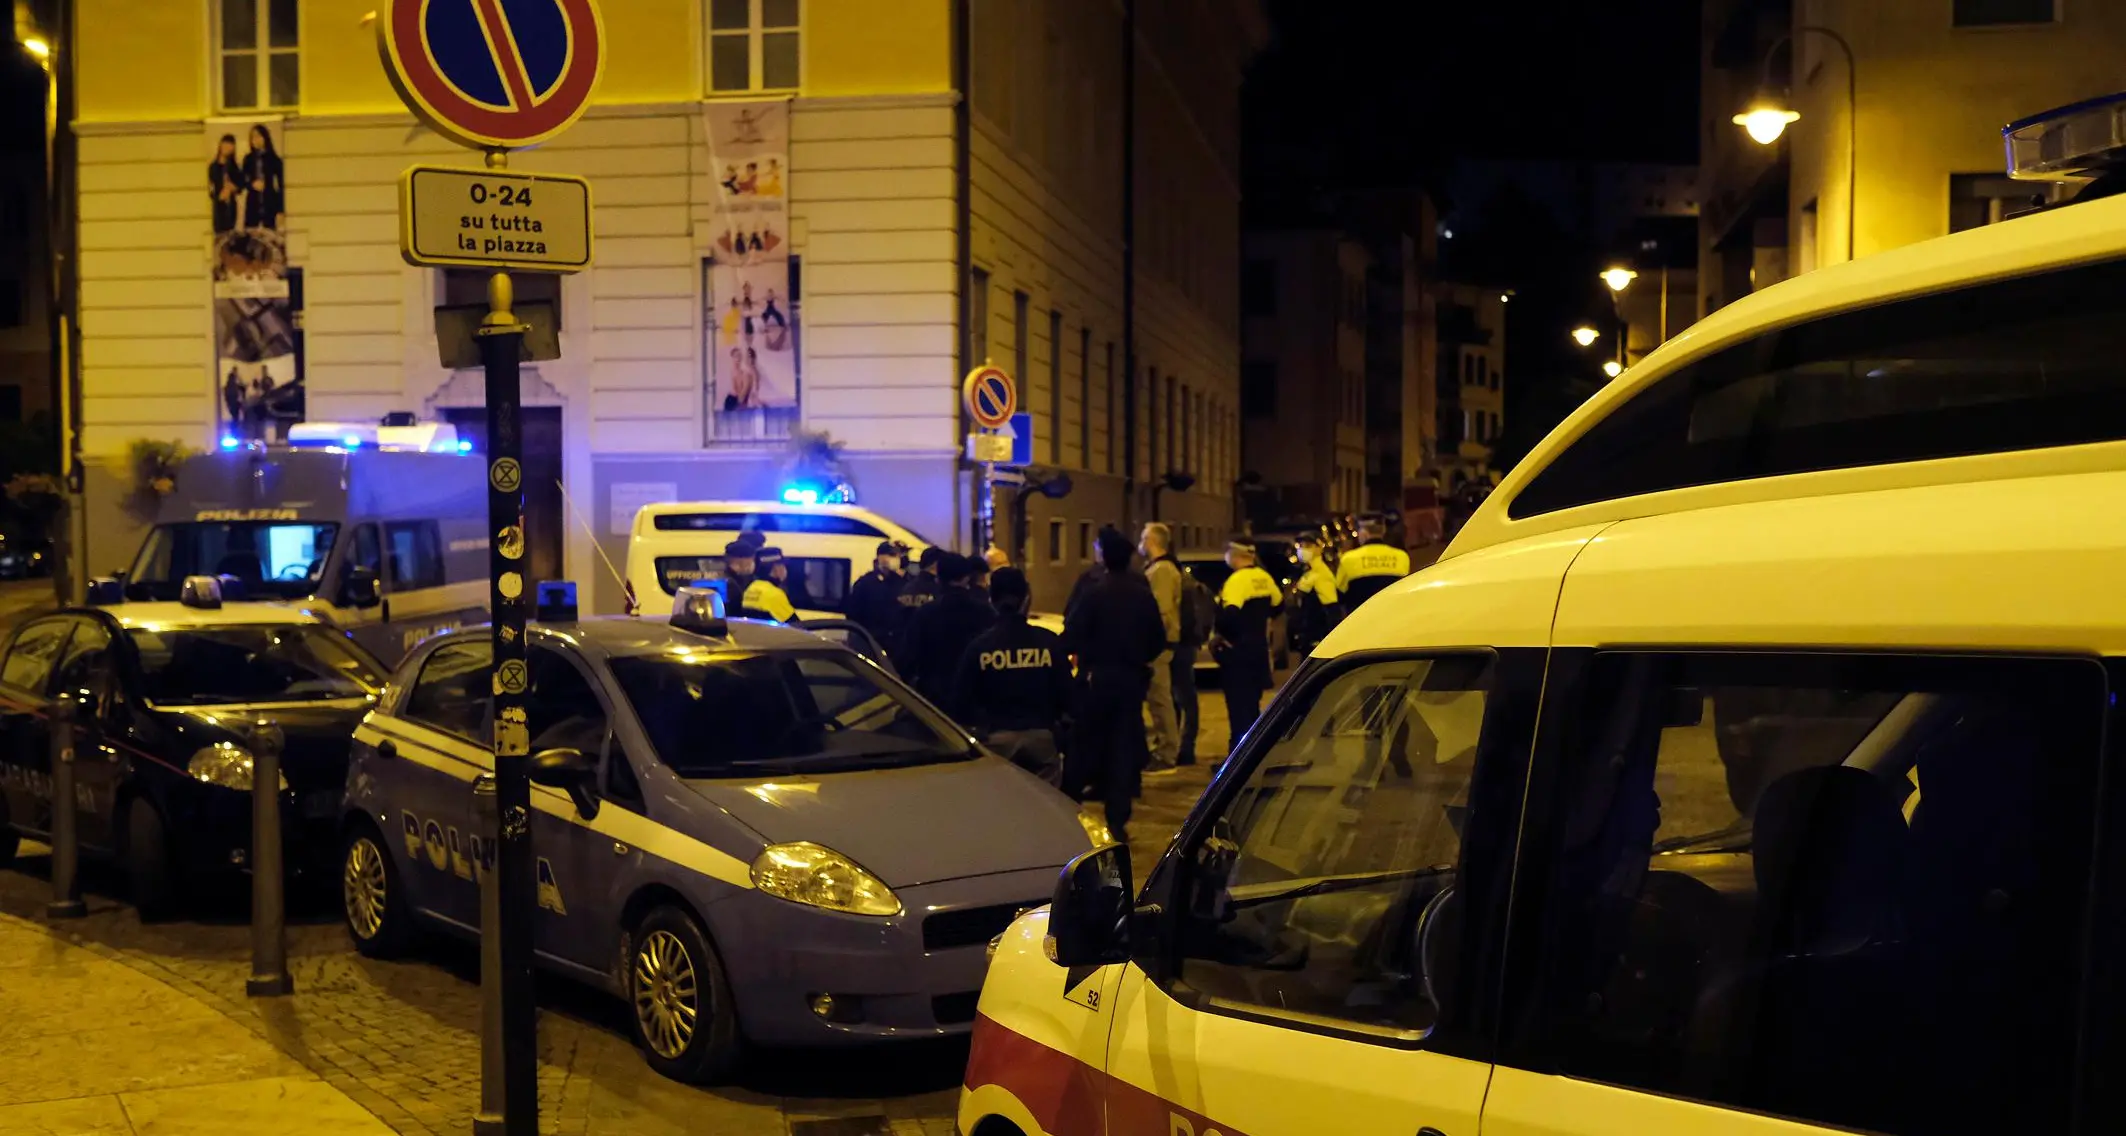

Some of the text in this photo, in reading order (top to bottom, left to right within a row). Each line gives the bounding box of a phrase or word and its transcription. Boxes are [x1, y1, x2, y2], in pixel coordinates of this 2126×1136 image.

[470, 184, 532, 207] 0-24
[461, 214, 543, 232] su tutta
[458, 233, 547, 254] la piazza
[979, 647, 1053, 673] POLIZIA
[401, 808, 568, 916] POLIA
[1086, 989, 1100, 1007] 52
